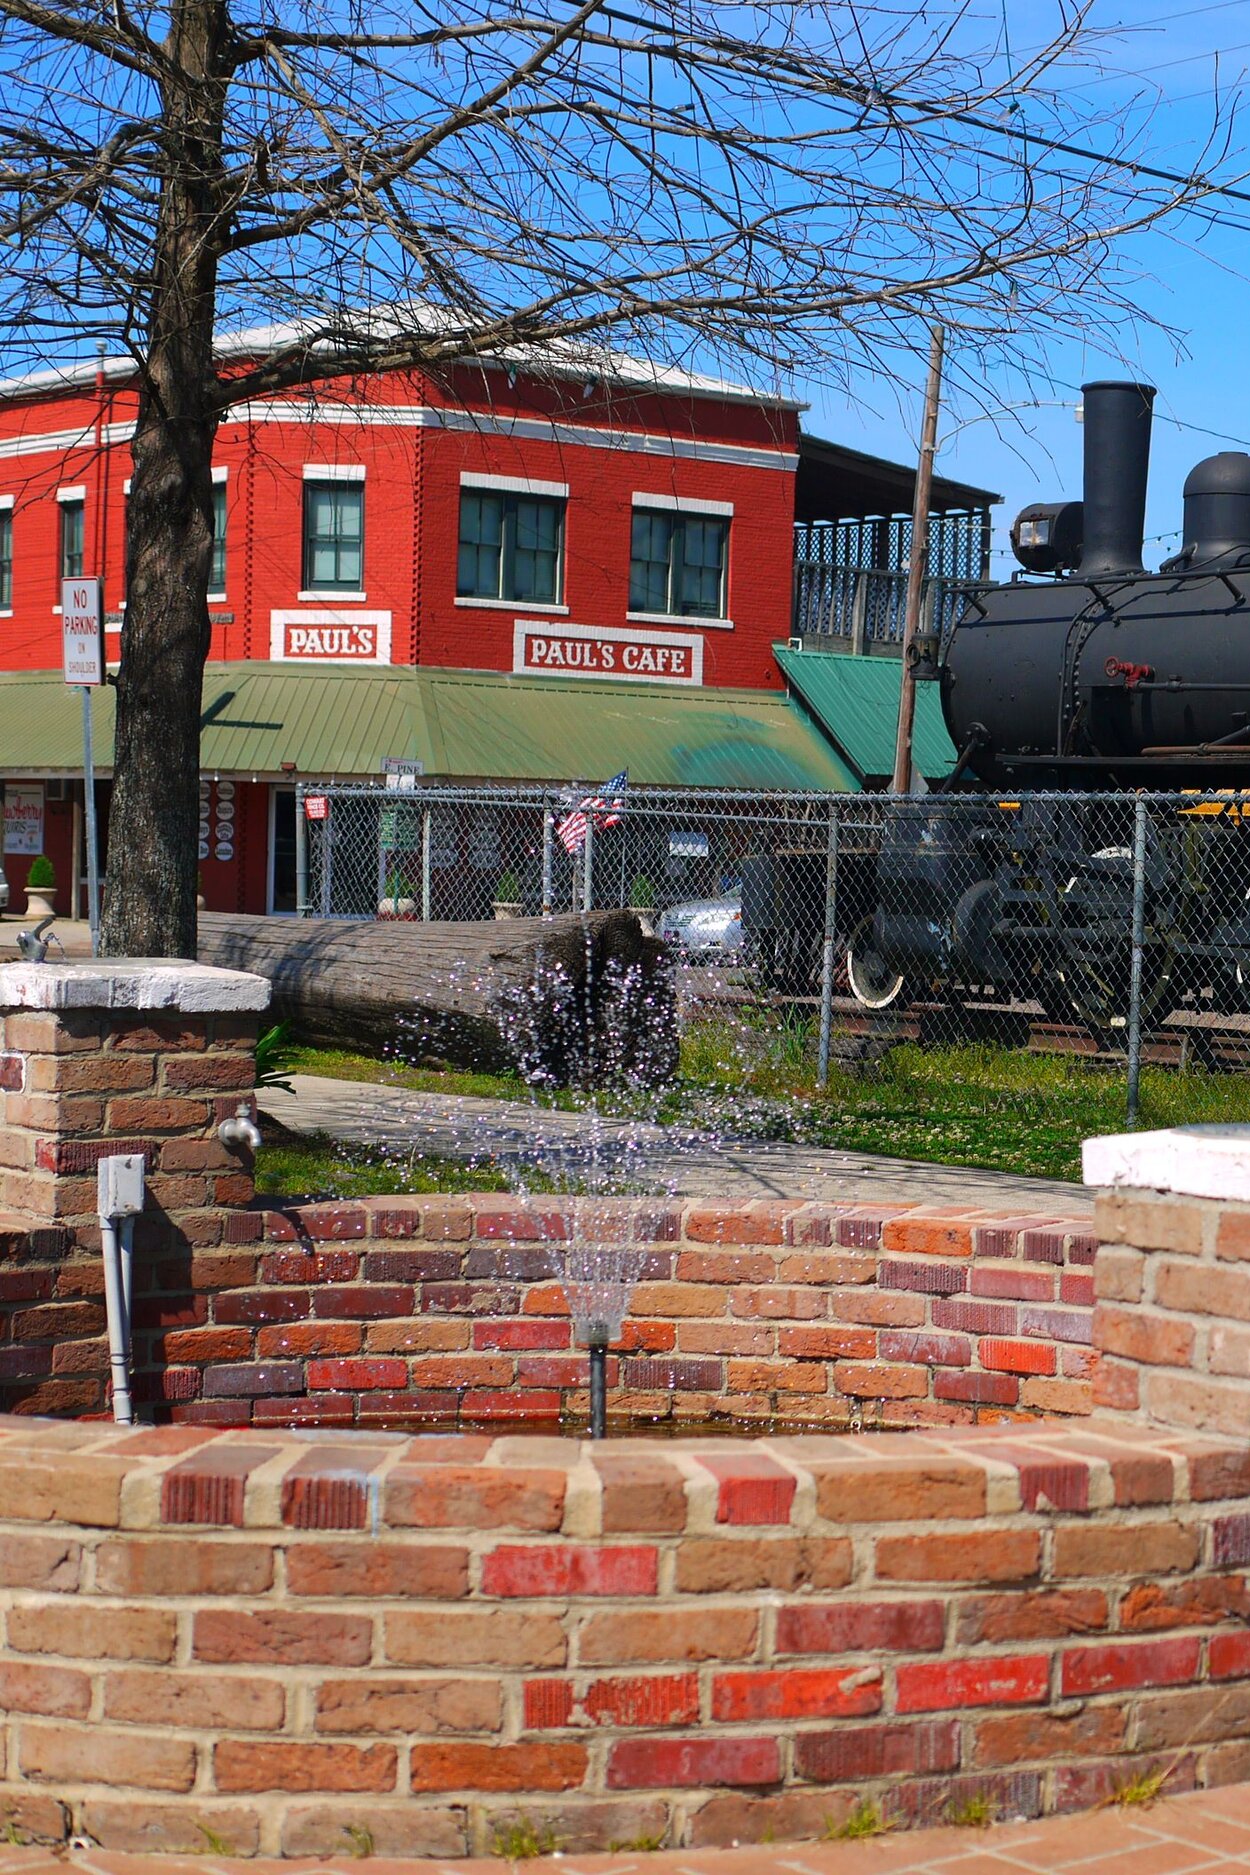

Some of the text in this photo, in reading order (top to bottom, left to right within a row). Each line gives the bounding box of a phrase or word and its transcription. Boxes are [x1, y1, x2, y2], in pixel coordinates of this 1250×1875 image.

[73, 589, 88, 609] NO
[65, 616, 97, 635] PARKING
[78, 643, 86, 654] ON
[289, 626, 373, 654] PAUL'S
[531, 639, 685, 673] PAUL'S CAFE
[69, 661, 96, 673] SHOULDER
[397, 764, 420, 775] PINE
